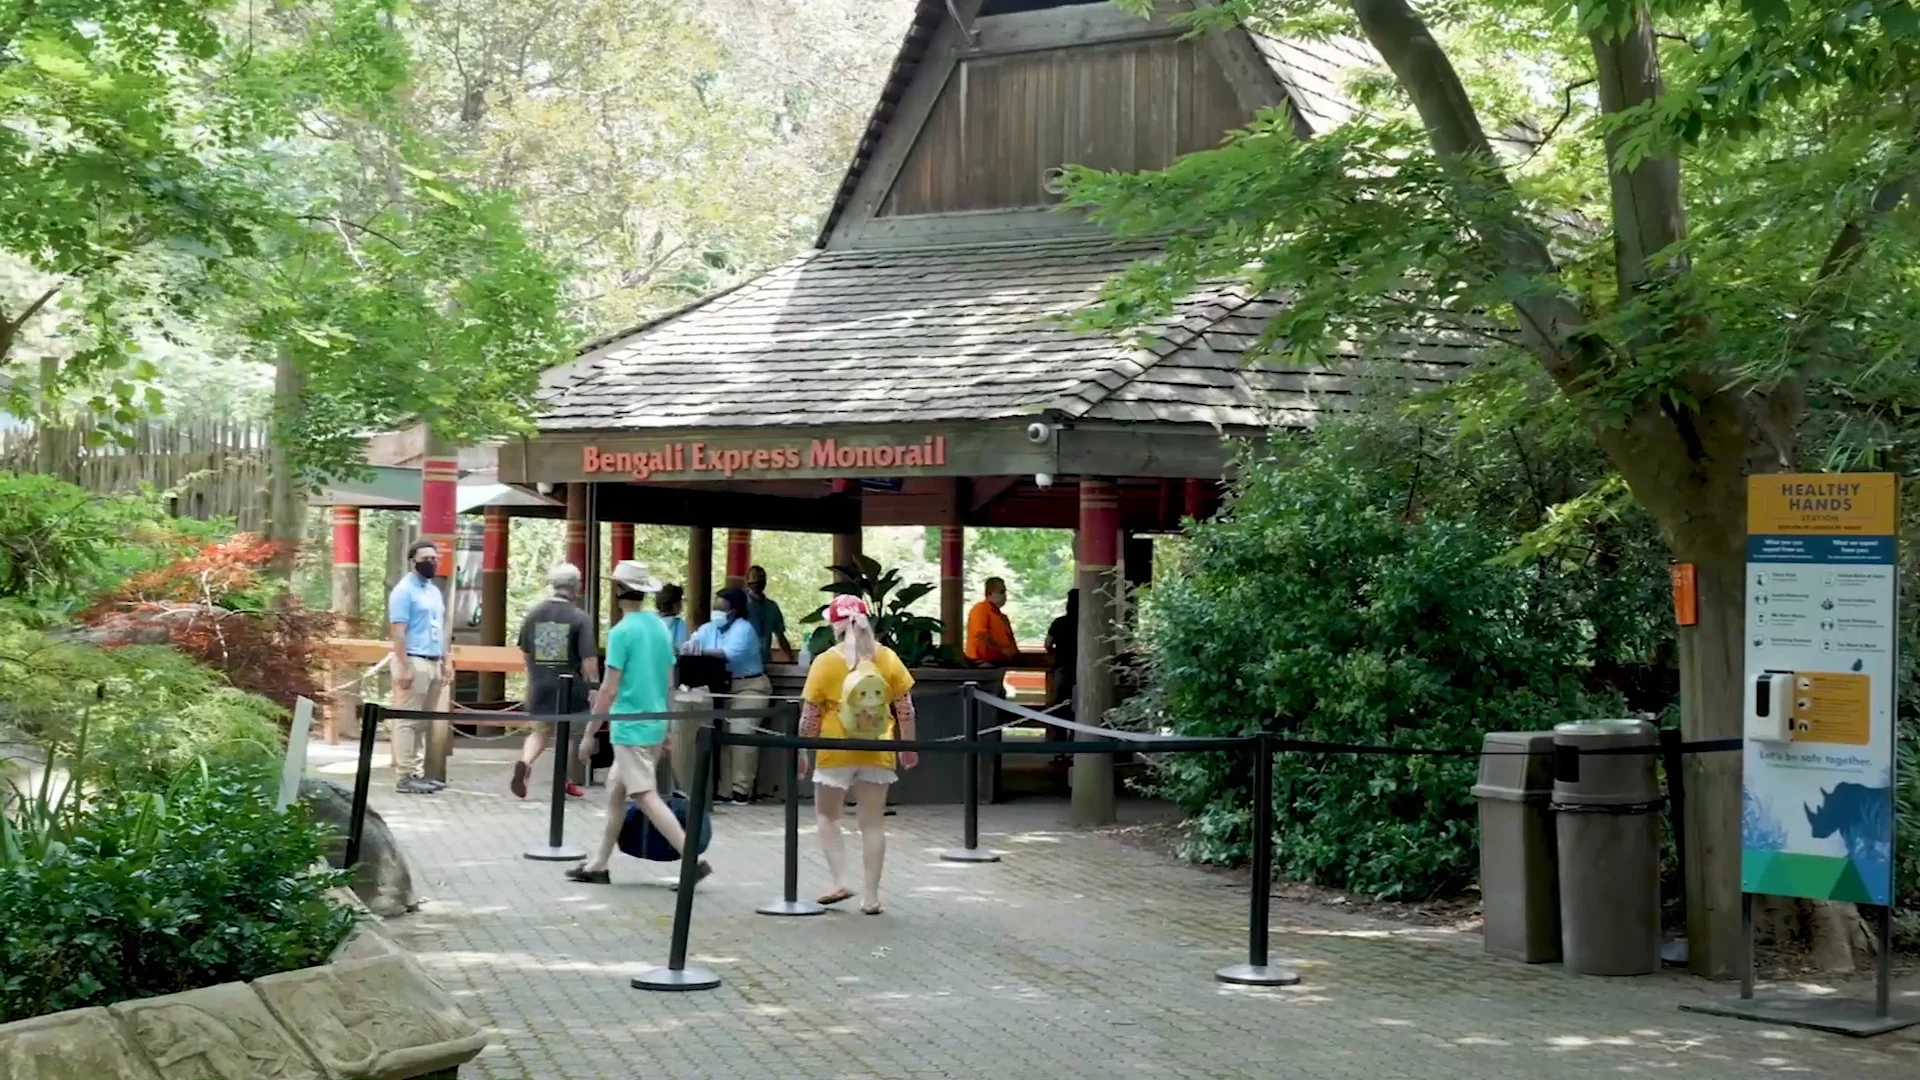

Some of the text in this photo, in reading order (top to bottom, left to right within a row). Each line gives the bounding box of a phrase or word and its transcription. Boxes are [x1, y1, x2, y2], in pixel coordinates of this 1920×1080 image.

[583, 436, 945, 479] Bengali Express Monorail
[1782, 483, 1861, 496] HEALTHY
[1789, 498, 1853, 511] HANDS
[1785, 752, 1798, 760] be
[1800, 753, 1822, 762] safe
